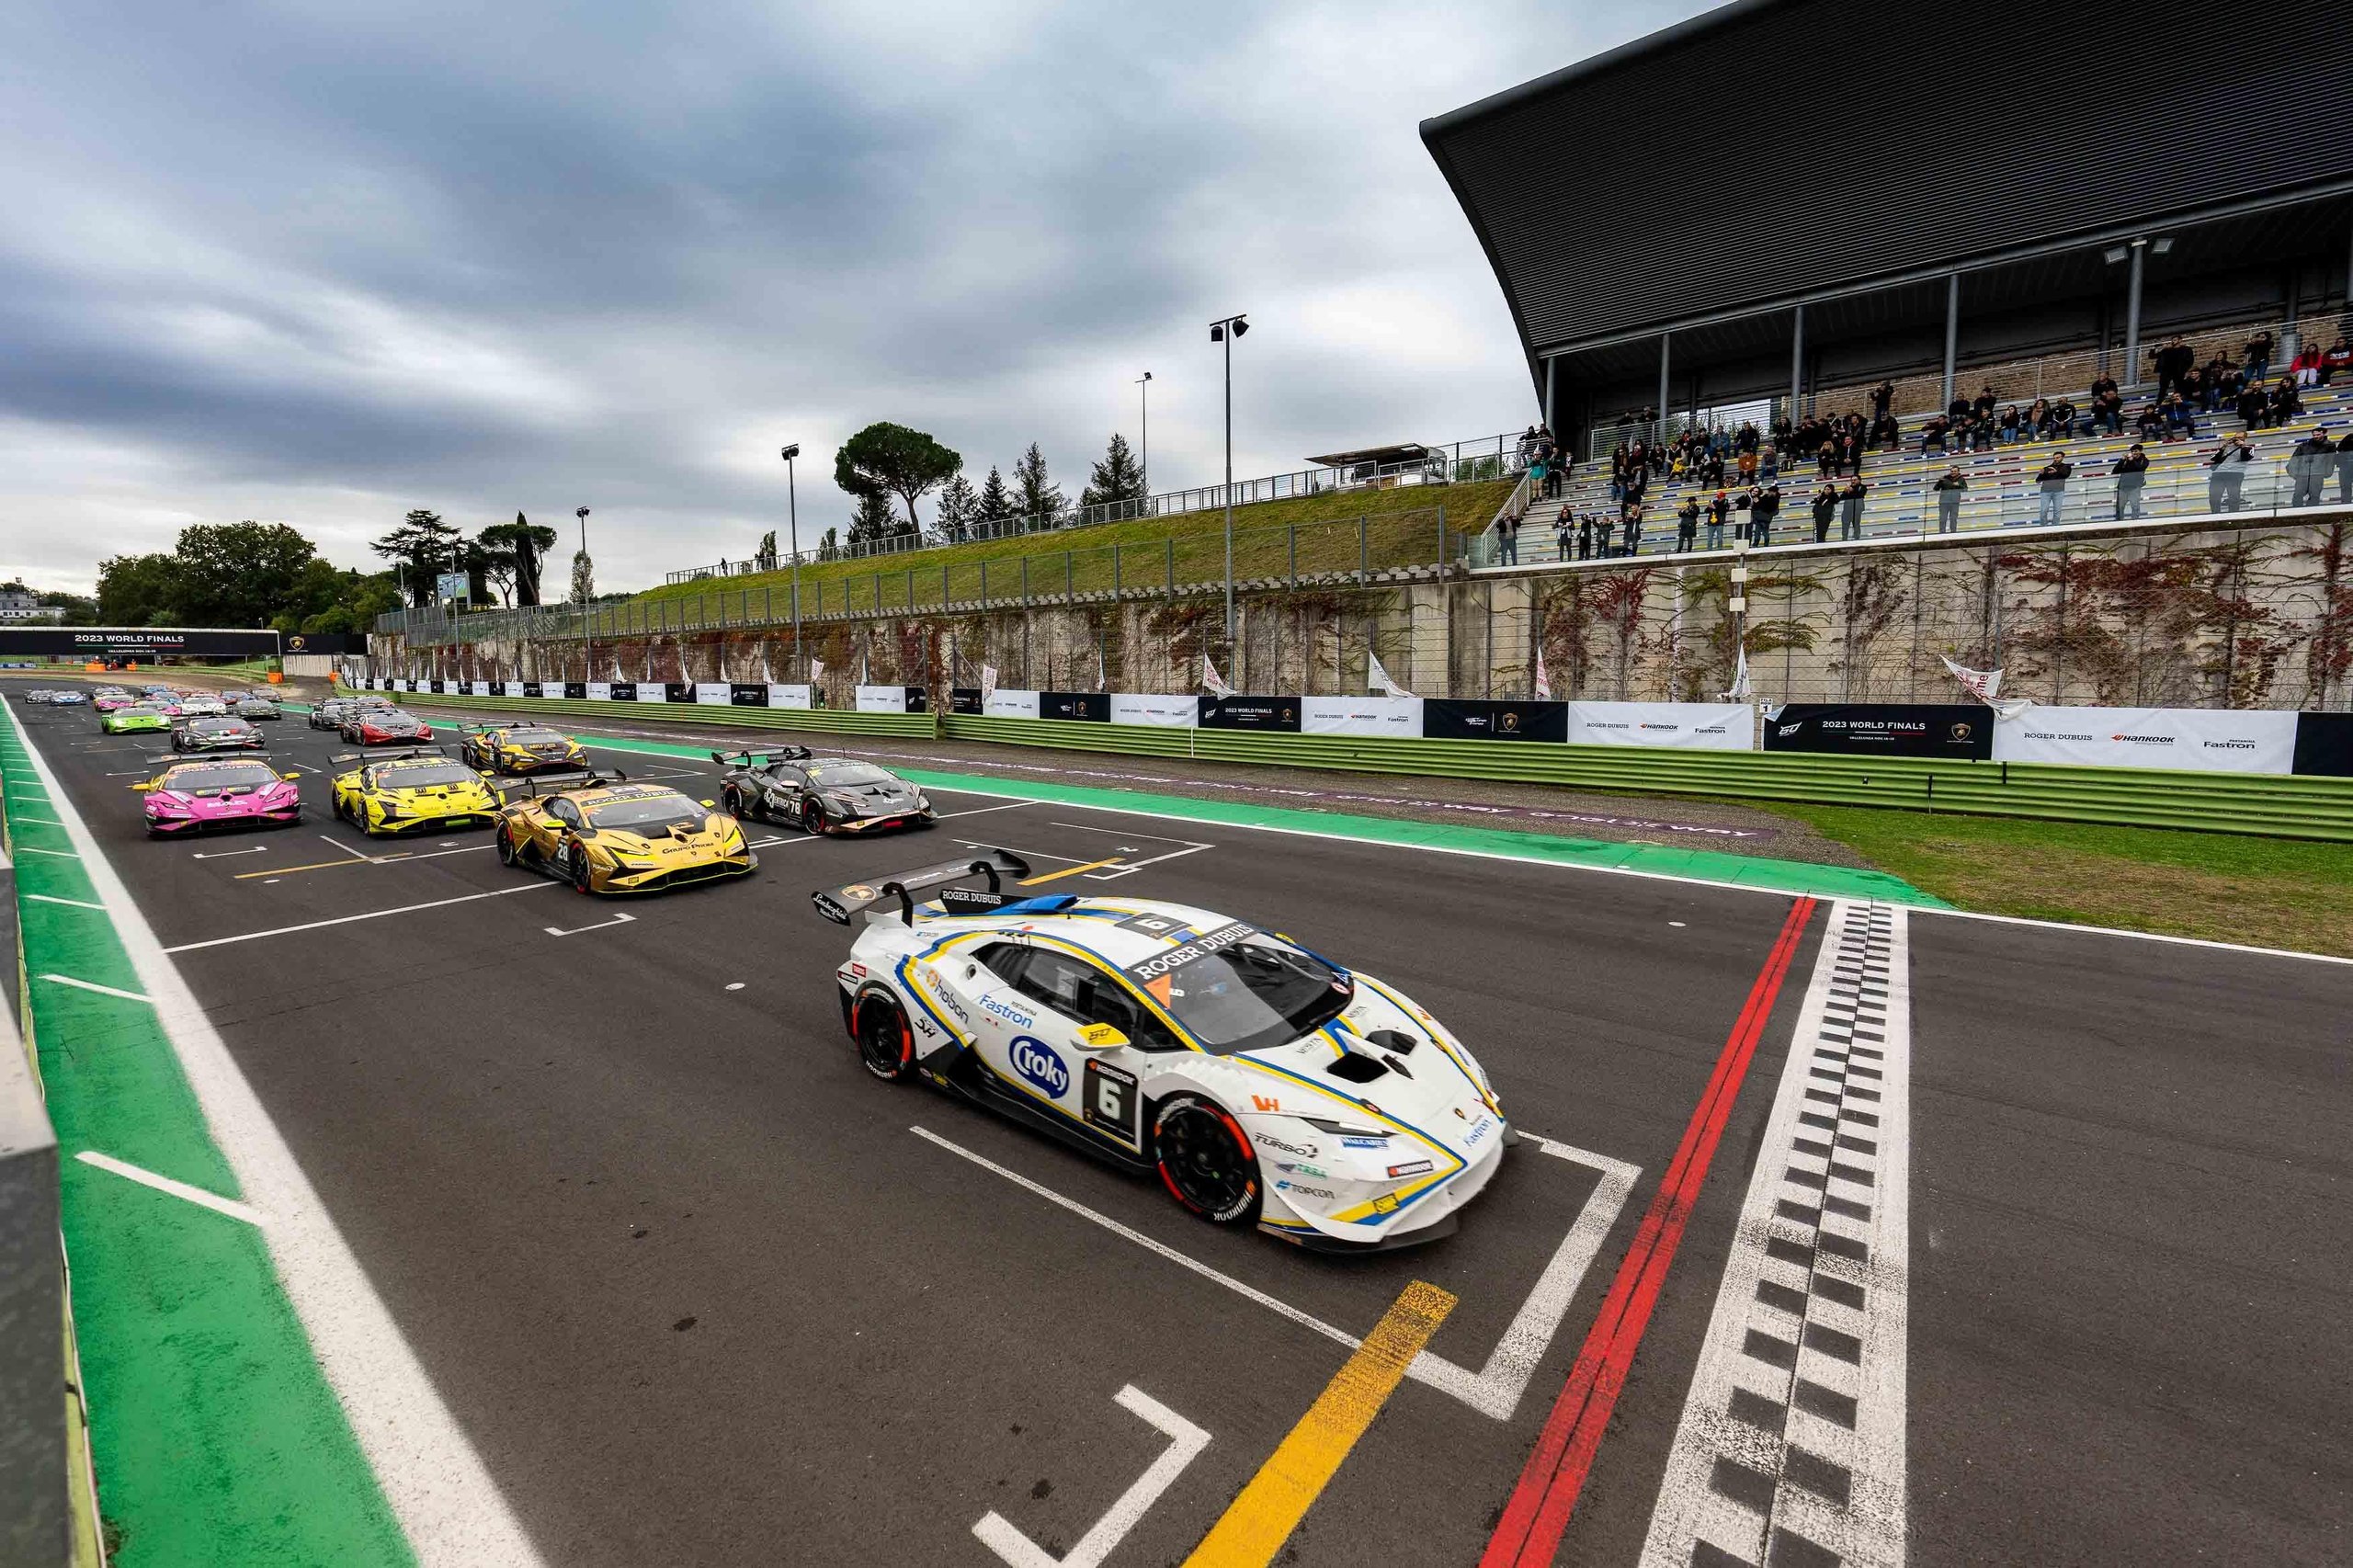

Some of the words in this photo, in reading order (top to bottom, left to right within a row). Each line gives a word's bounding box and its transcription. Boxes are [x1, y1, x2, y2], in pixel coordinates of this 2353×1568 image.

[75, 634, 103, 642] 2023
[1822, 721, 1847, 729] 2023
[1849, 721, 1884, 729] WORLD
[1887, 722, 1926, 730] FINALS
[2204, 741, 2256, 749] Fastron
[586, 795, 631, 805] ROGER
[635, 790, 678, 799] DUBUIS
[790, 801, 801, 815] 78
[558, 842, 568, 862] 28
[942, 890, 970, 902] ROGER
[971, 892, 1002, 904] DUBUIS
[1133, 946, 1204, 980] ROGER
[1199, 924, 1255, 950] DUBUIS
[934, 978, 971, 1024] hobon
[979, 994, 1033, 1029] Fastron
[1012, 1040, 1067, 1092] Croky
[1098, 1077, 1121, 1120] 6
[1255, 1131, 1306, 1155] TURBO
